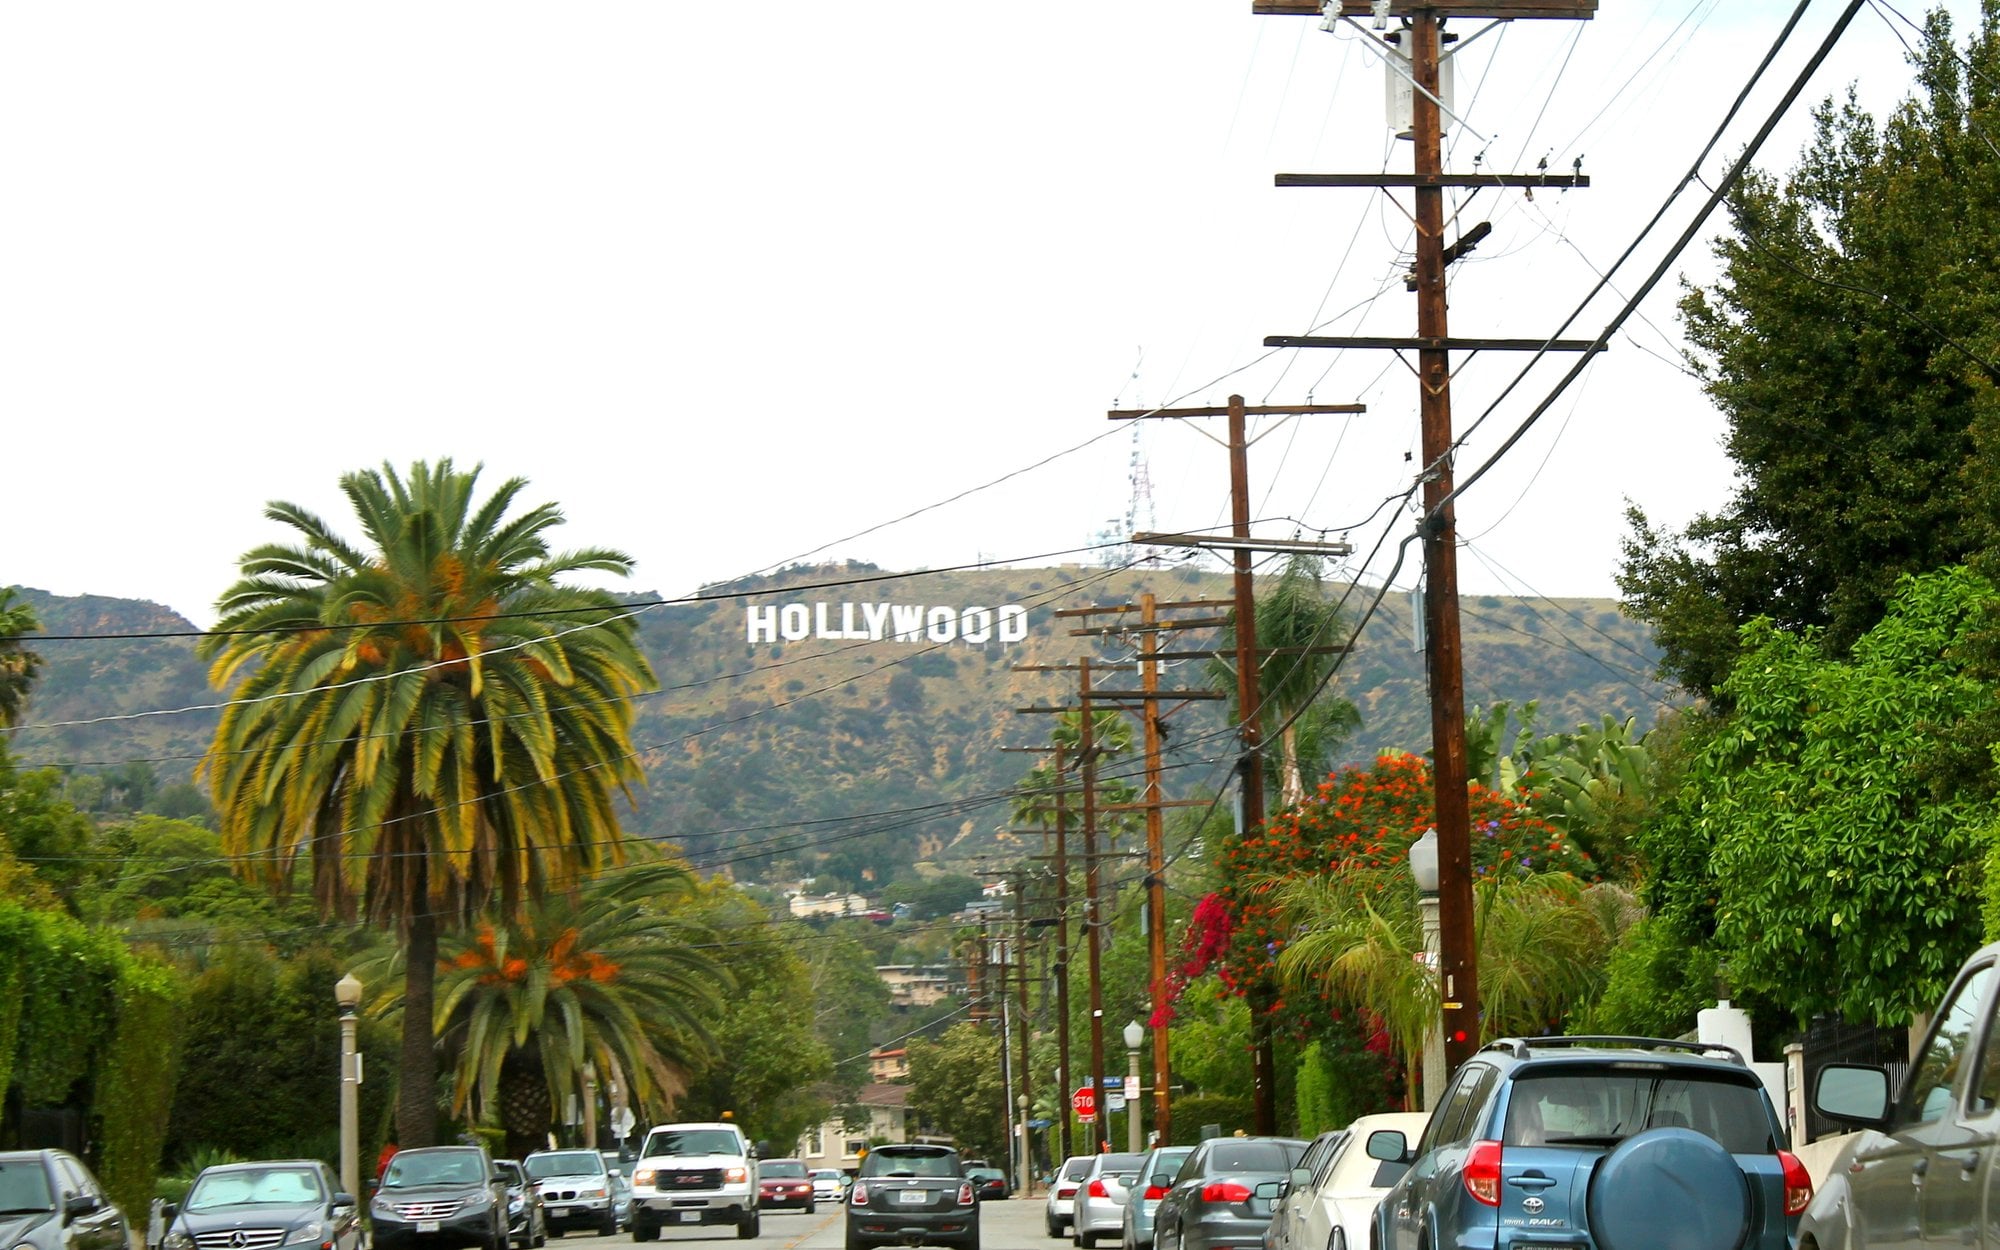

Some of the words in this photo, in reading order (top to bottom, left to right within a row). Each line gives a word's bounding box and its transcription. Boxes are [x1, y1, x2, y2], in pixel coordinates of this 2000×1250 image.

[747, 602, 1028, 643] HOLLYWOOD
[1074, 1095, 1094, 1108] STO
[1529, 1218, 1565, 1226] RAV4
